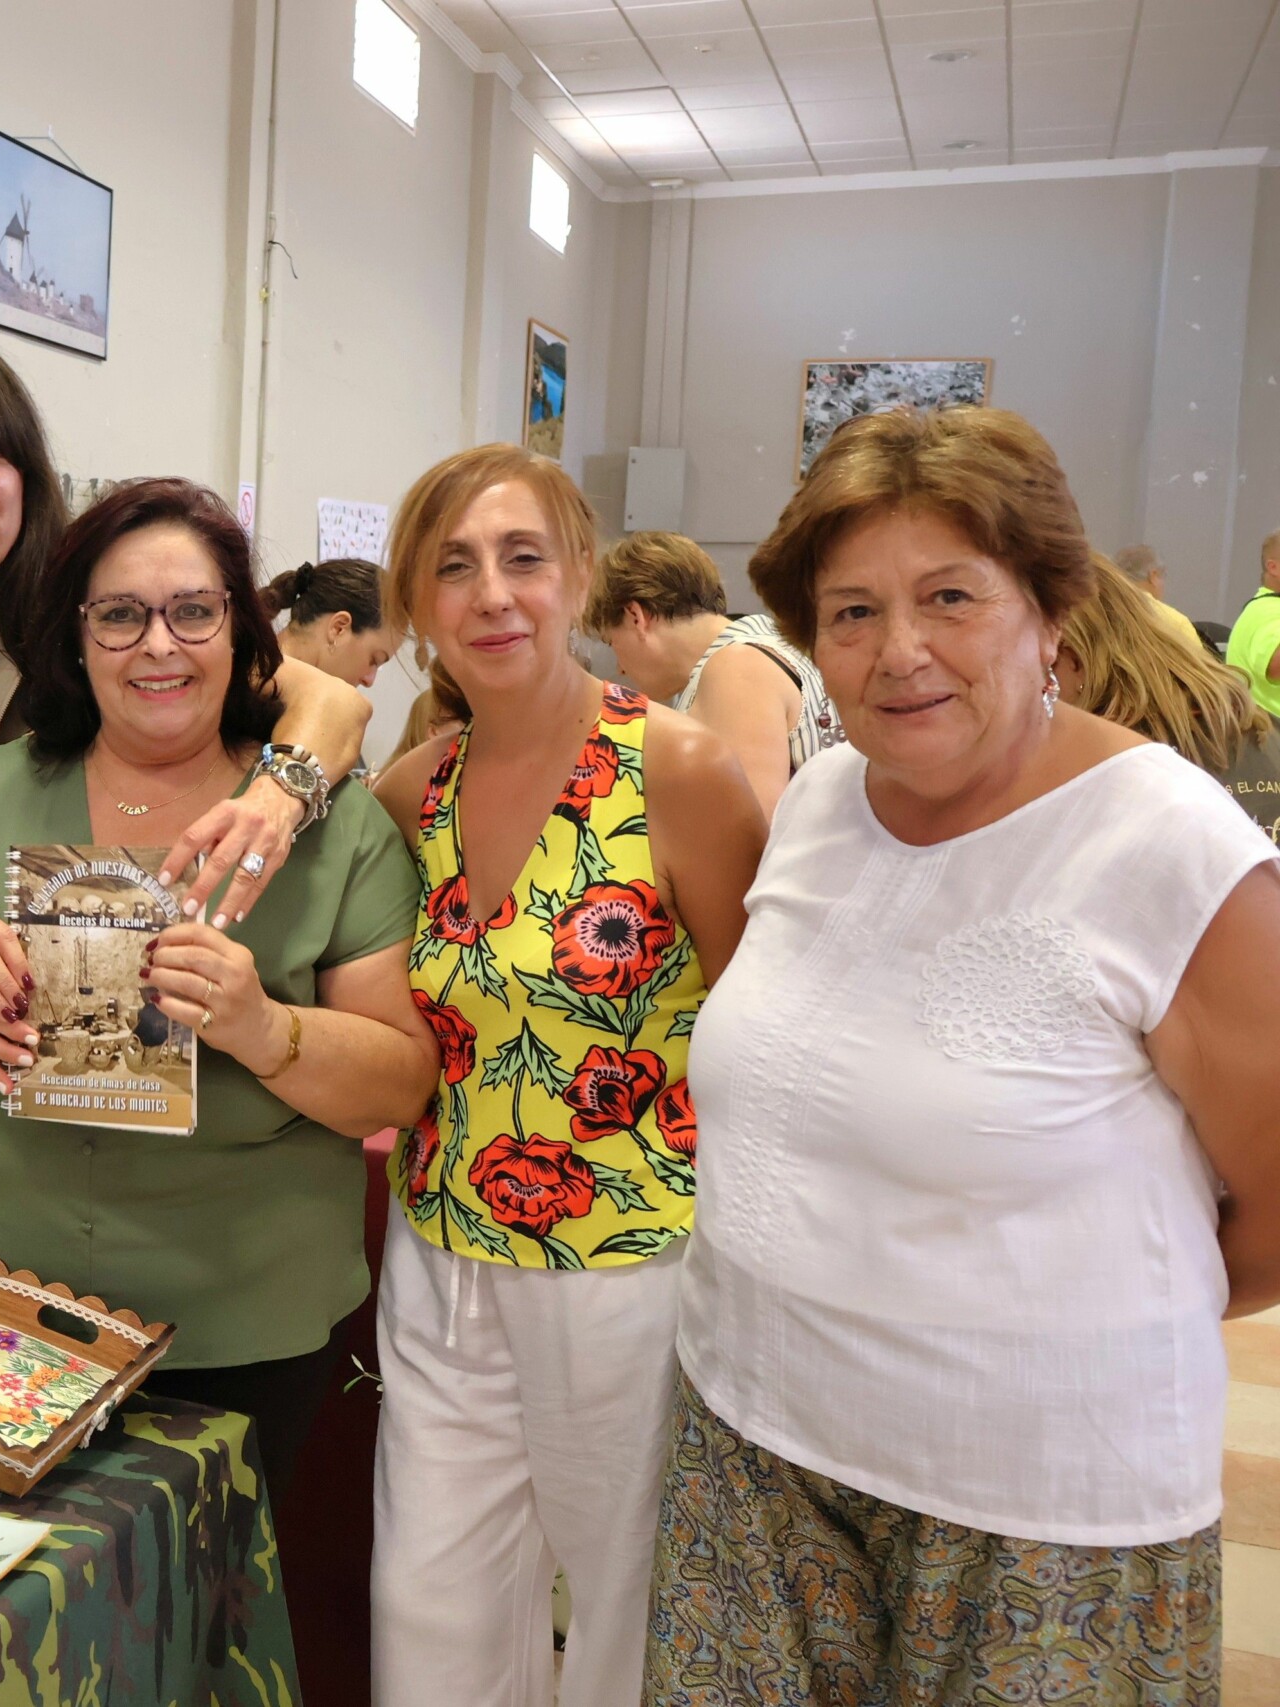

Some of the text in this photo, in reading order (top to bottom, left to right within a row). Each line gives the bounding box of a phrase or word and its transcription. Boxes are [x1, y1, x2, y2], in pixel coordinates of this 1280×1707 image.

[1237, 780, 1253, 794] EL
[37, 867, 75, 906] LEGADO
[74, 863, 90, 878] DE
[91, 860, 145, 884] NUESTRAS
[59, 914, 146, 928] Recetas de cocina
[41, 1073, 161, 1092] Asociación de Amas de Casa
[35, 1091, 168, 1113] DE HORCAJO DE LOS MONTES
